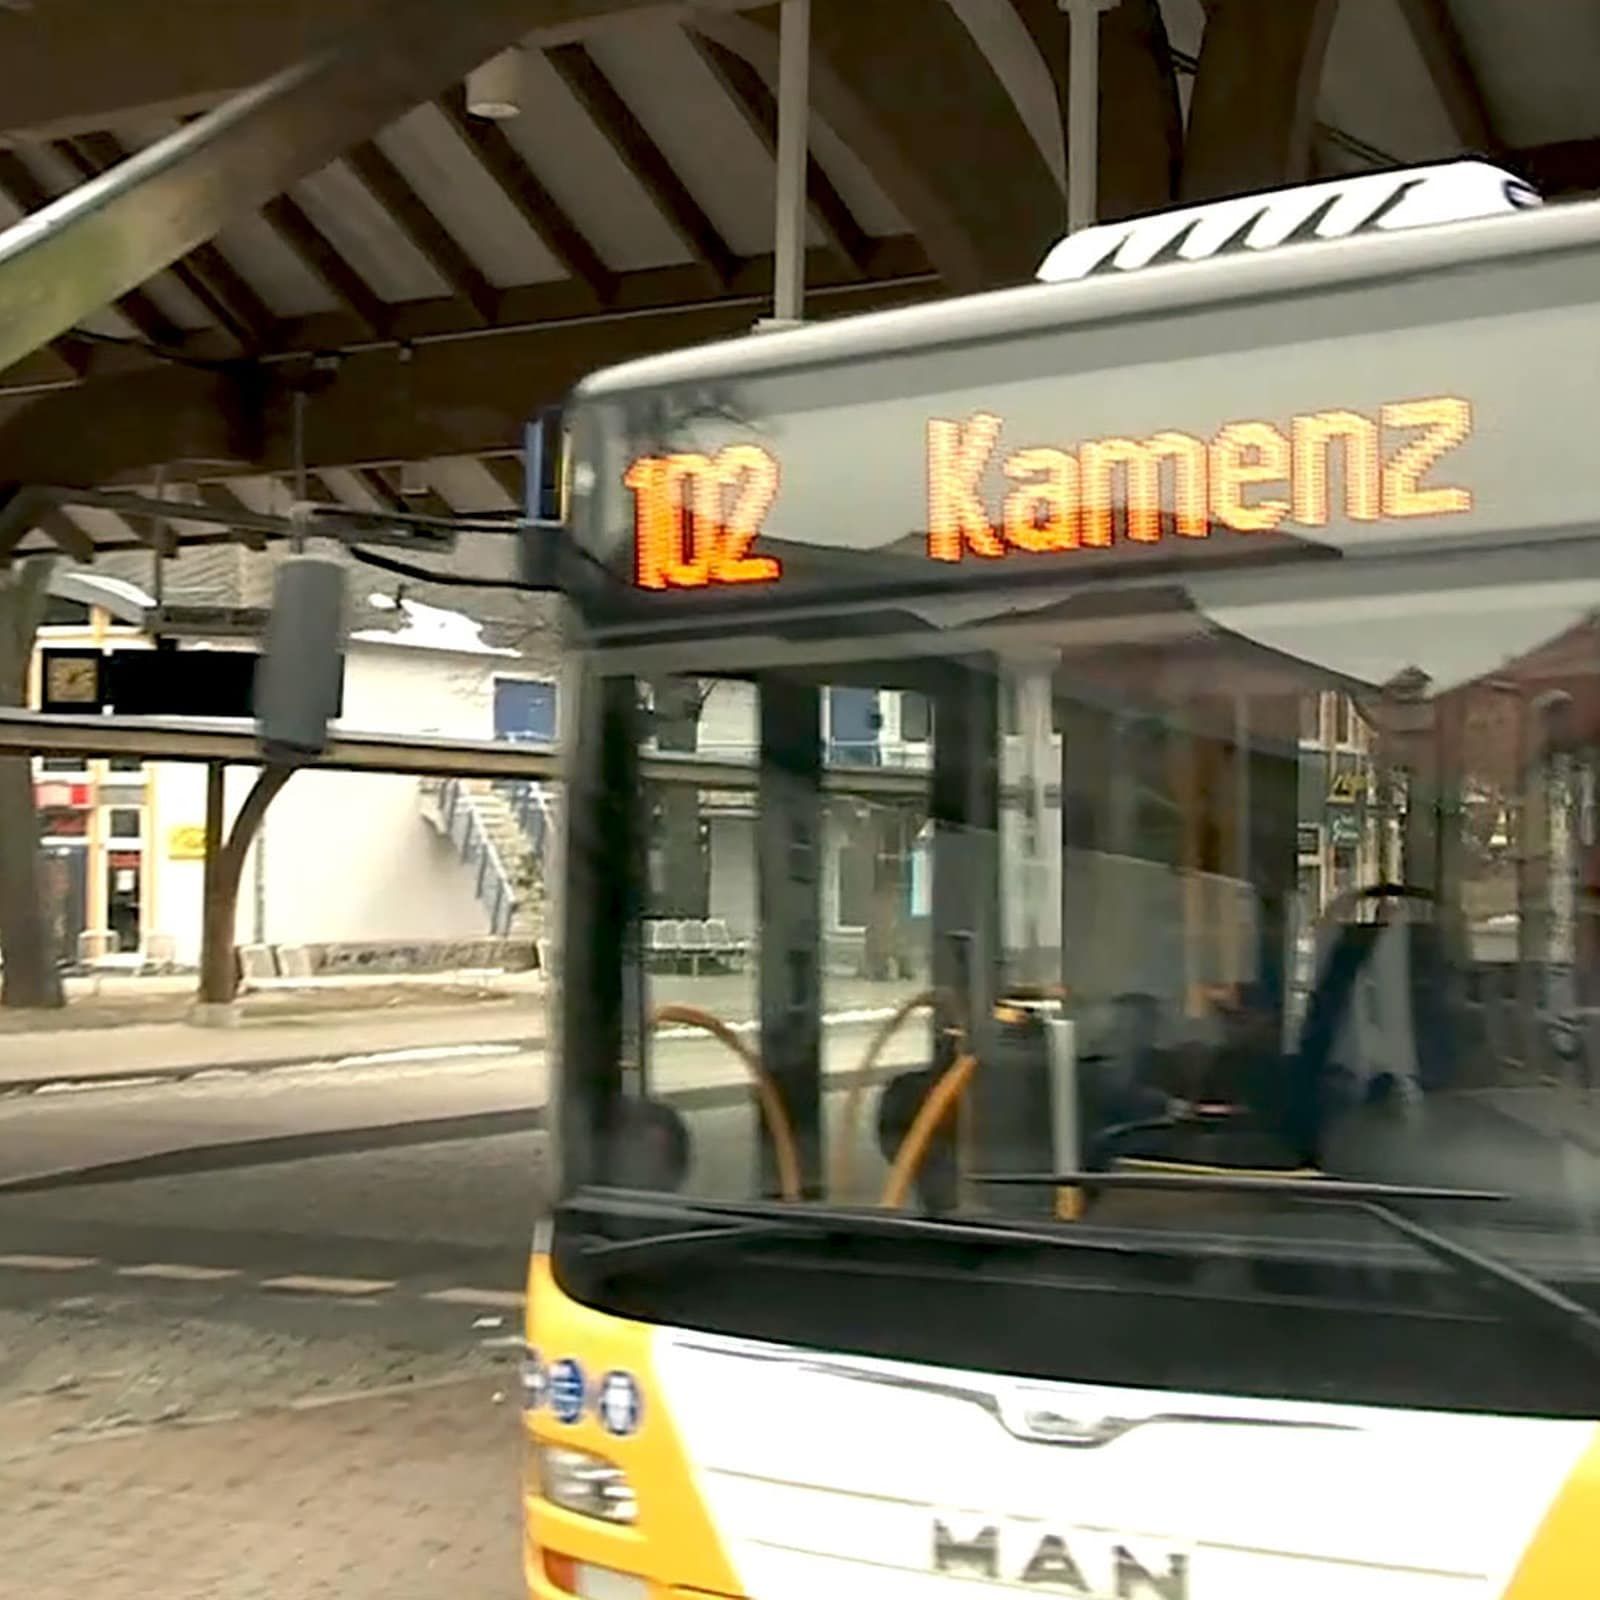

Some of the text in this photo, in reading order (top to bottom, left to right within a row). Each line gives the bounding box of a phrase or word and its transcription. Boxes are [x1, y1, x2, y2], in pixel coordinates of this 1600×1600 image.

[623, 395, 1474, 590] 102 Kamenz
[933, 1517, 1188, 1600] MAN
